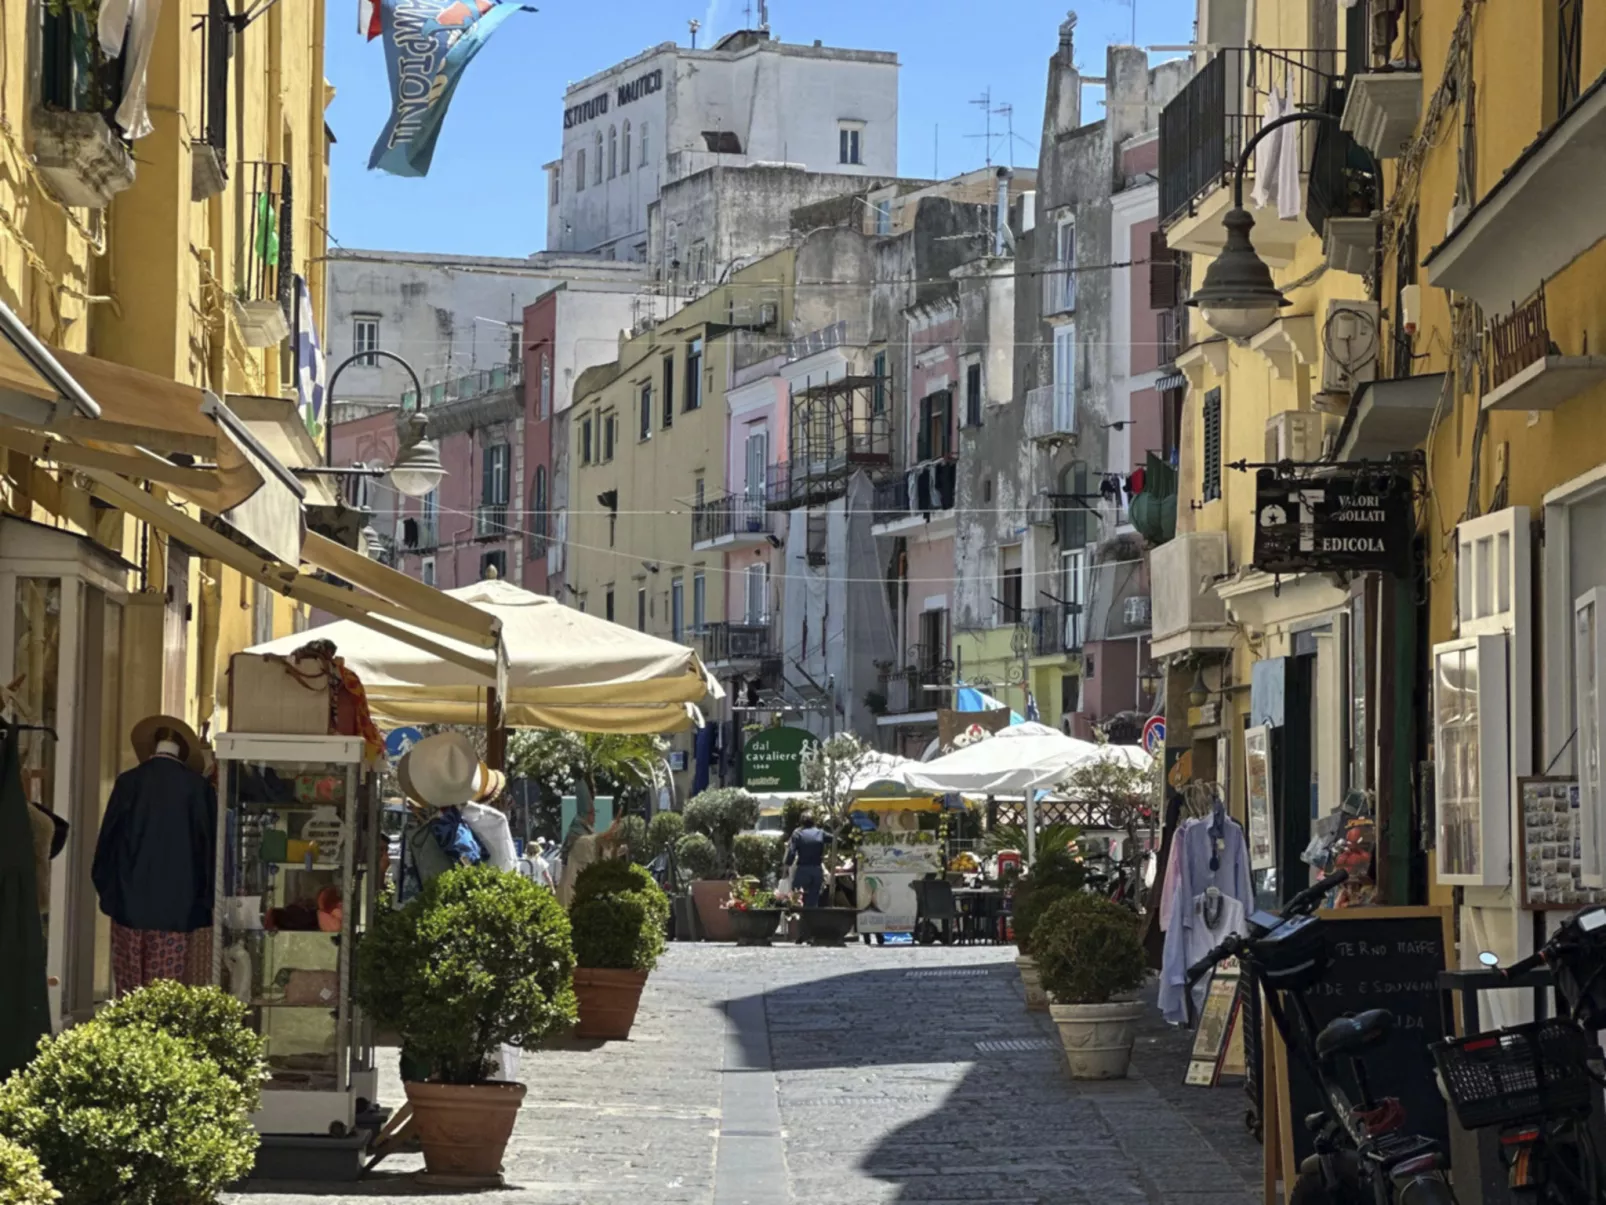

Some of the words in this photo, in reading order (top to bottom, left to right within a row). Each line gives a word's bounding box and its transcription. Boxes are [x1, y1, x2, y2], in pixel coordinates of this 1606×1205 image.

[563, 92, 608, 129] ISTITUTO
[617, 68, 662, 107] NAUTICO
[1338, 495, 1379, 507] VALORI
[1338, 510, 1385, 522] BOLLATI
[1322, 537, 1385, 551] EDICOLA
[752, 740, 769, 751] dal
[745, 751, 797, 761] cavaliere
